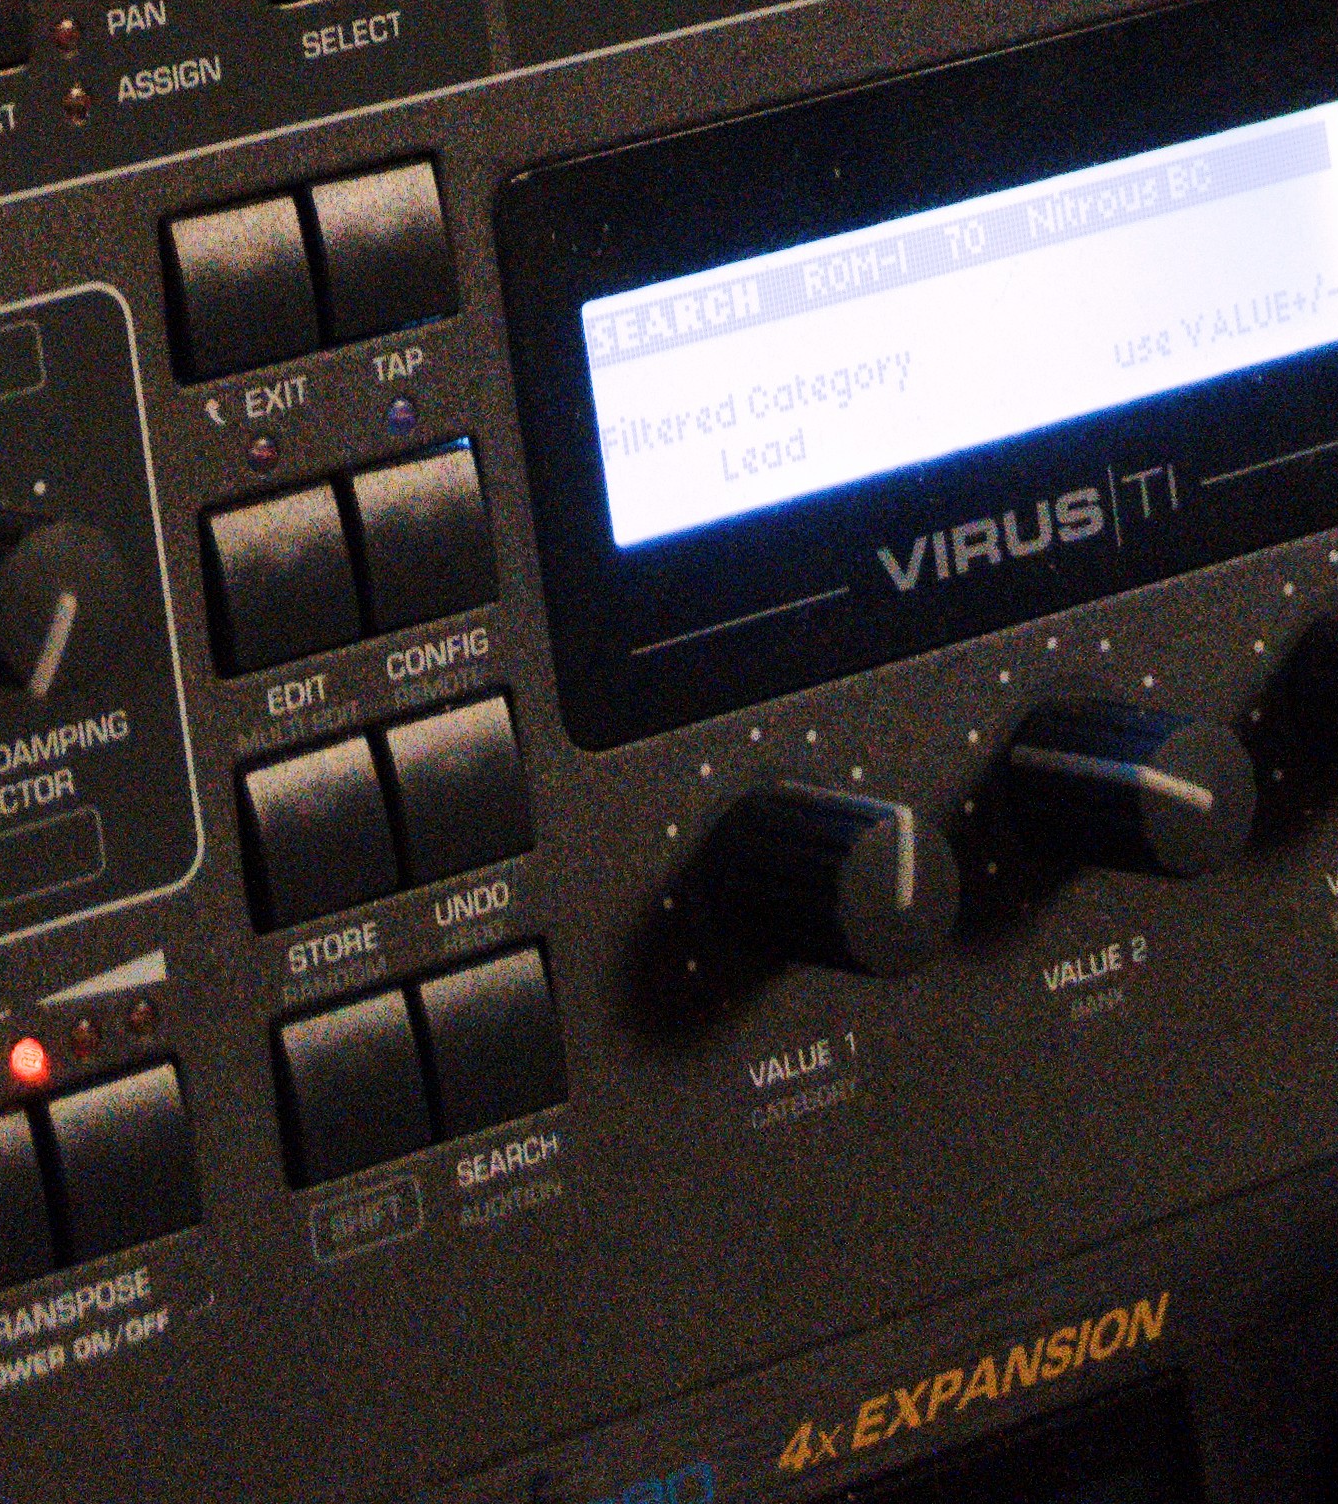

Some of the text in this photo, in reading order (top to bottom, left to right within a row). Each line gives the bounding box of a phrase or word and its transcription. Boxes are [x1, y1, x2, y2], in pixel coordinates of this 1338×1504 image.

[106, 0, 167, 36] PAN
[301, 11, 402, 59] SELECT
[117, 56, 222, 103] ASSIGN
[372, 348, 425, 382] TAP
[244, 375, 308, 419] EXIT
[877, 487, 1104, 591] VIRUS
[386, 628, 490, 681] CONFIG
[267, 674, 326, 716] EDIT
[434, 881, 511, 927] UNDO
[287, 922, 378, 974] STORE
[850, 1291, 1168, 1450] EXPANSION
